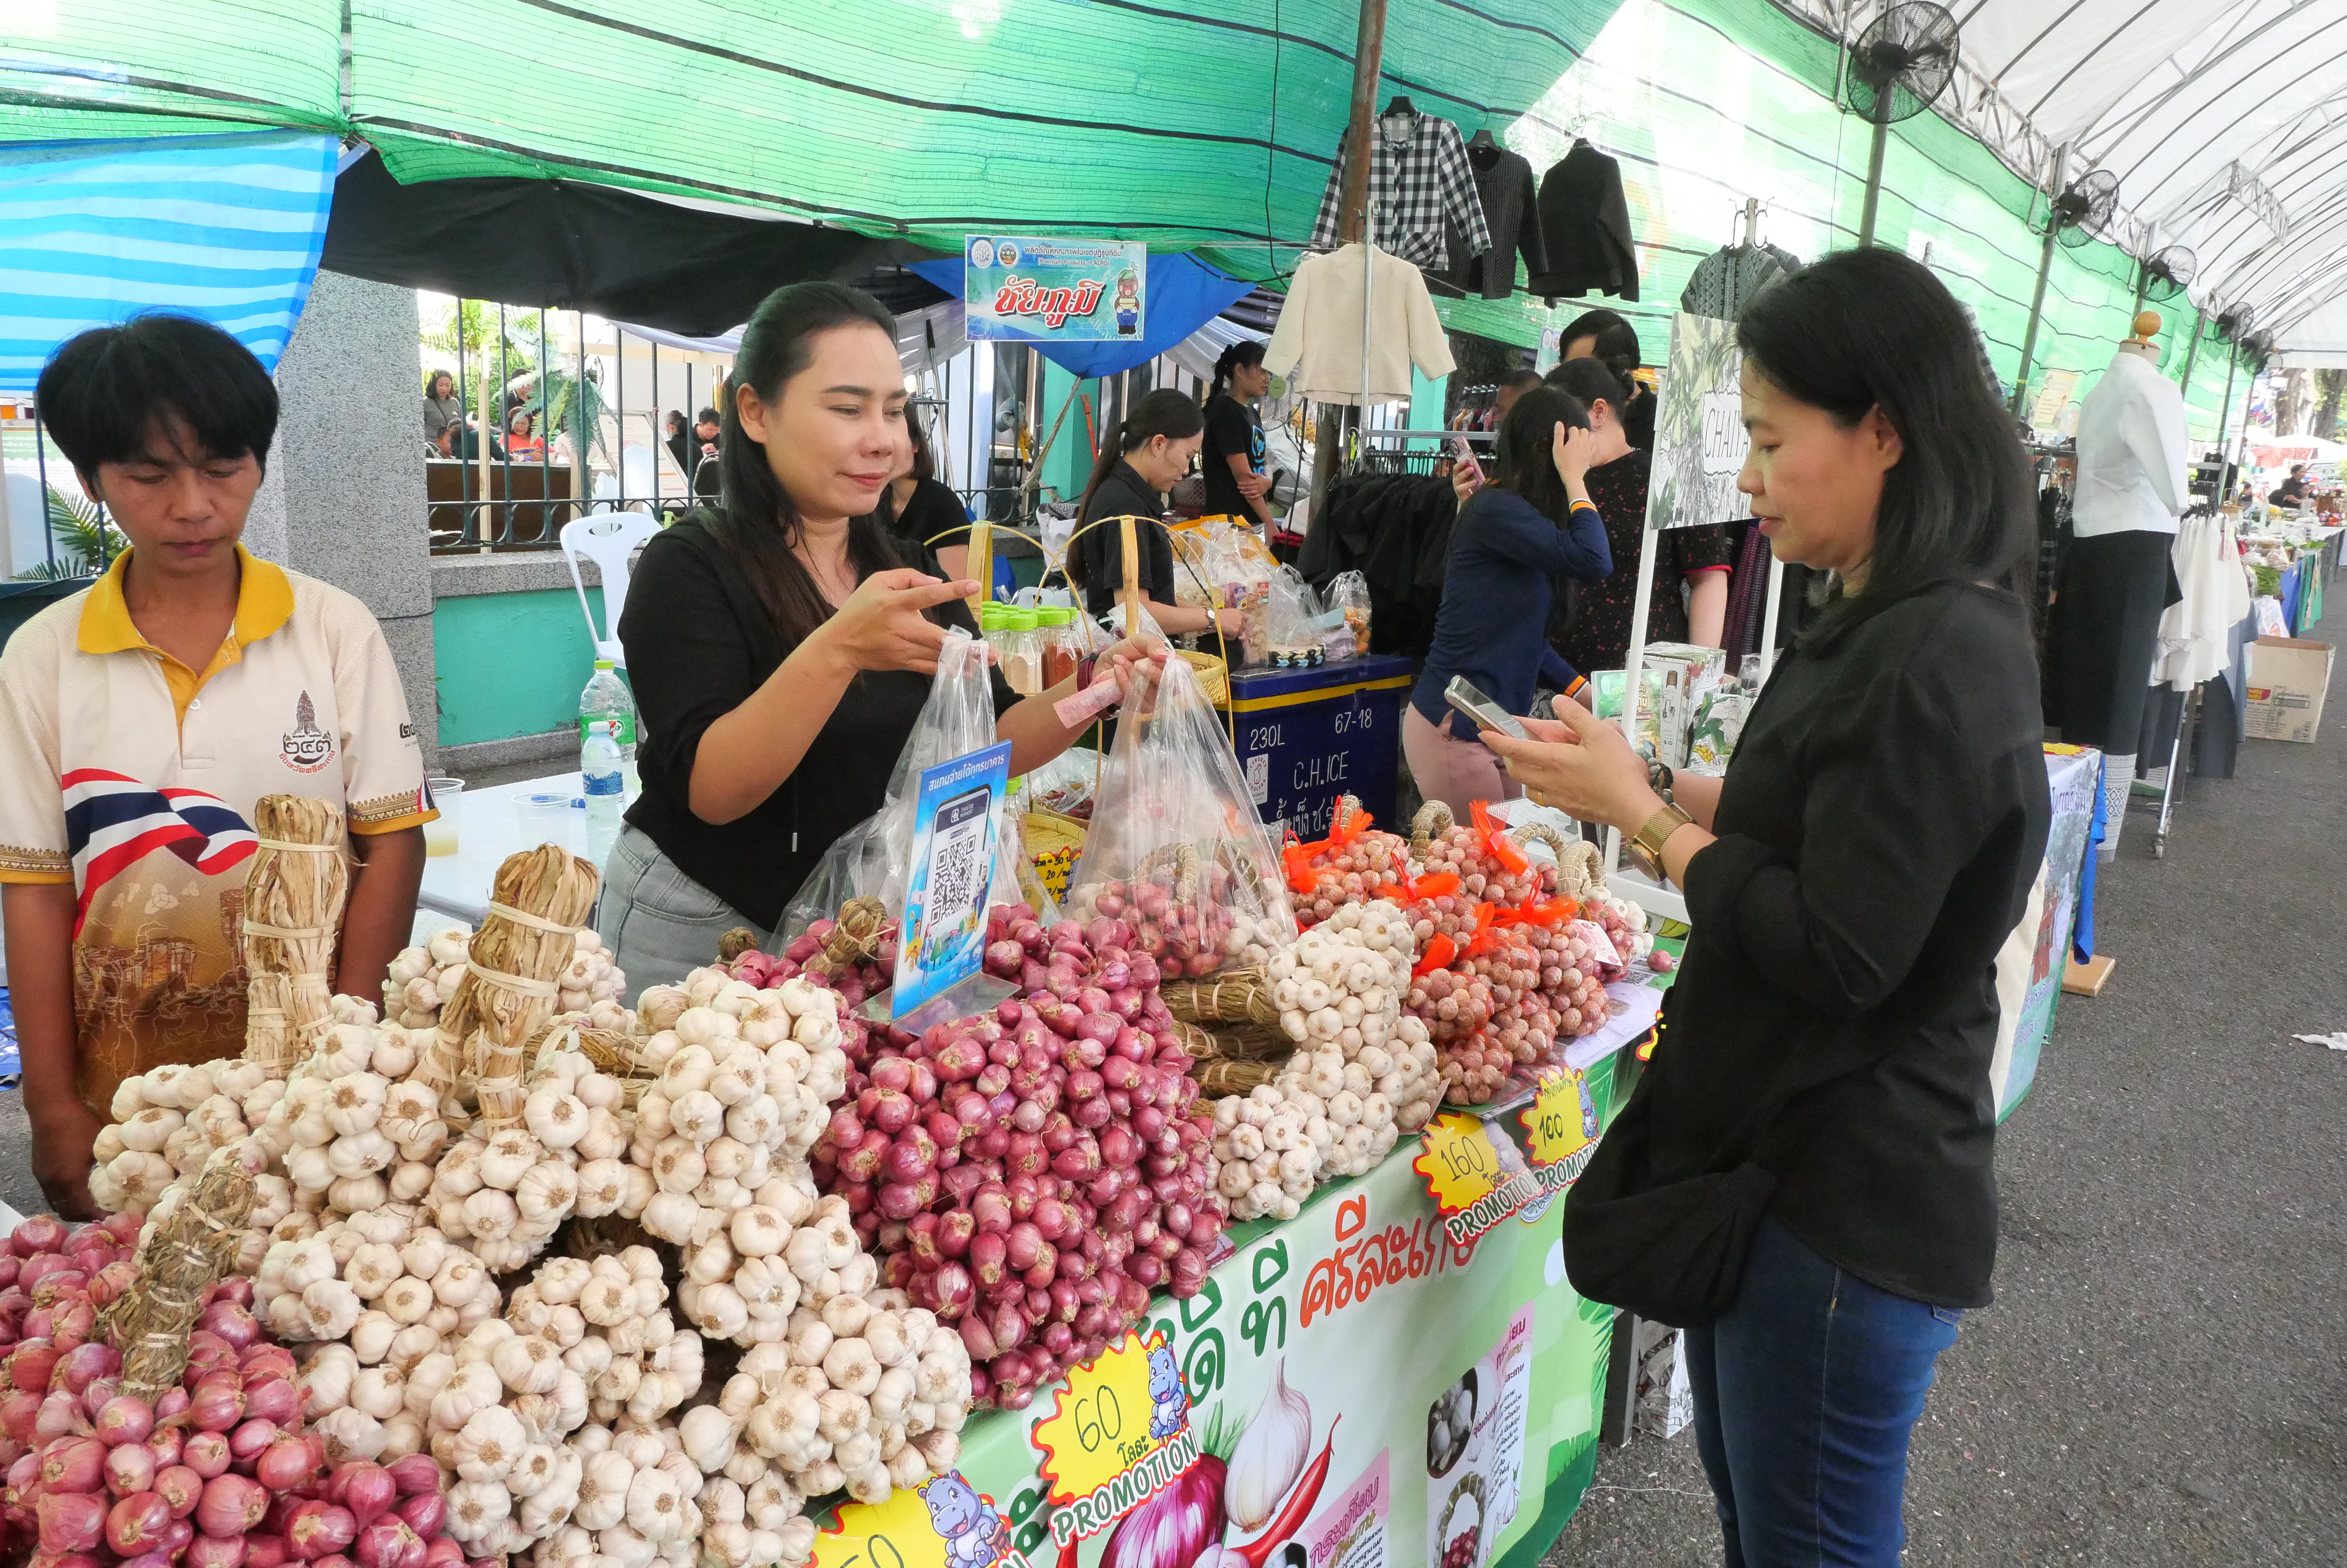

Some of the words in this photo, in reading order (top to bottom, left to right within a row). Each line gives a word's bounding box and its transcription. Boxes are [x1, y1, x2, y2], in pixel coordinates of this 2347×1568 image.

[995, 276, 1104, 328] ชัยภูมิ
[1705, 407, 1751, 458] CHAIYA
[1250, 724, 1285, 750] 230L
[1335, 708, 1372, 734] 67-18
[928, 754, 1005, 791] สแกนจ่ายได้ทุกธนาคาร
[1539, 1113, 1563, 1148] 100
[1441, 1136, 1485, 1182] 160
[1447, 1172, 1543, 1243] PROMOTION
[1074, 1384, 1123, 1453] 60
[1053, 1426, 1200, 1545] PROMOTION
